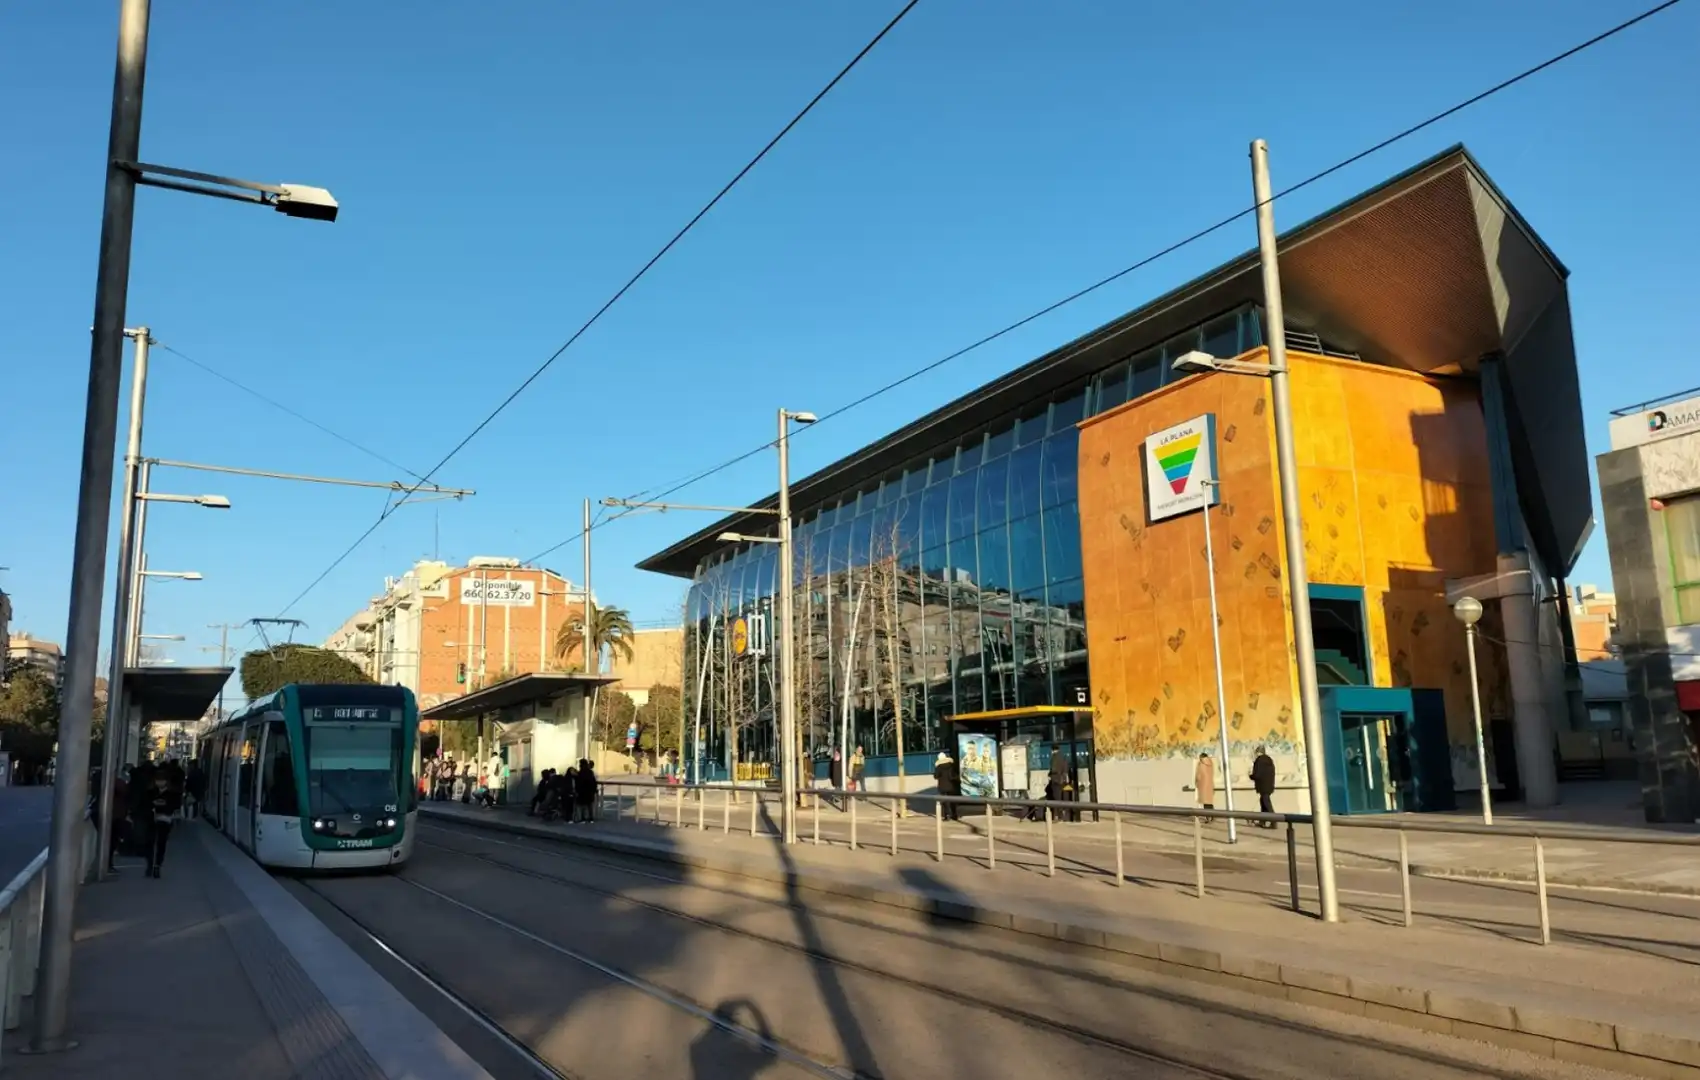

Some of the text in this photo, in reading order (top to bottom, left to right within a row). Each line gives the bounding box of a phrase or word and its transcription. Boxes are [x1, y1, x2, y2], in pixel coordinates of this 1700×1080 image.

[1160, 428, 1193, 445] LA PLANA
[464, 589, 531, 600] 66062.3720
